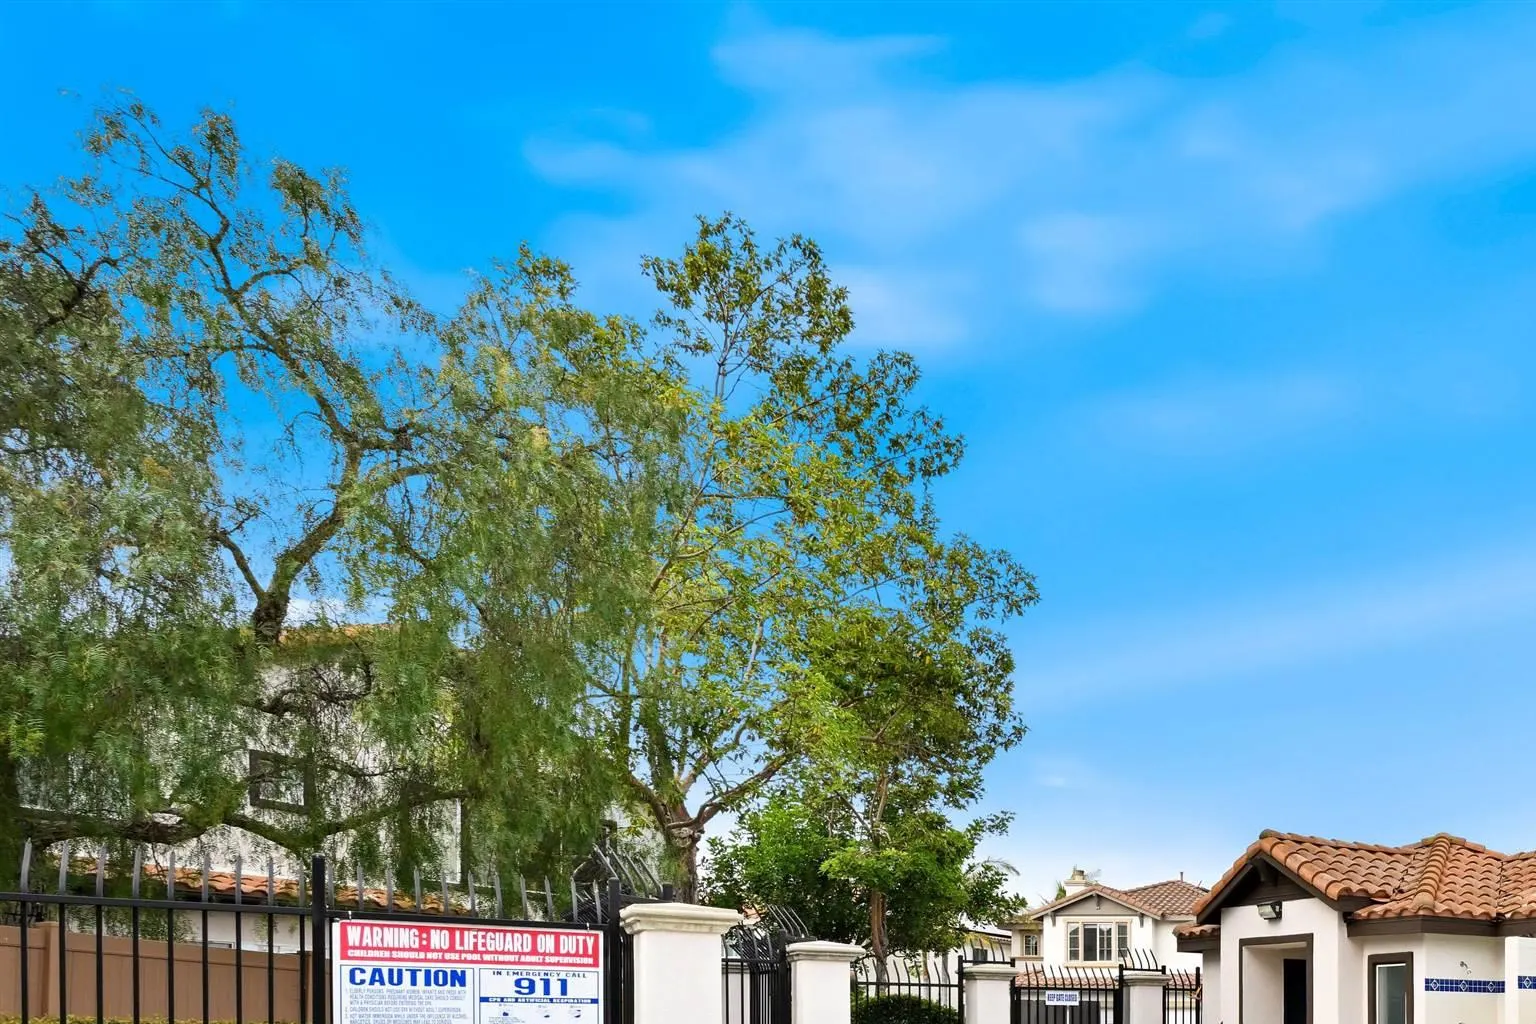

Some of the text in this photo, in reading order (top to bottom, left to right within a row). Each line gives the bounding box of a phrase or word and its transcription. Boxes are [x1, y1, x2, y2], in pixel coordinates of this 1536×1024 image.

[430, 929, 449, 950] NO
[455, 930, 532, 953] LIFEGUARD
[537, 934, 555, 954] ON
[560, 935, 594, 955] DUTY
[347, 949, 594, 964] CHILDREN SHOULD NOT USE POOL WITHOUT ADULT SUPERVISION
[349, 967, 466, 987] CAUTION
[514, 977, 568, 996] 911
